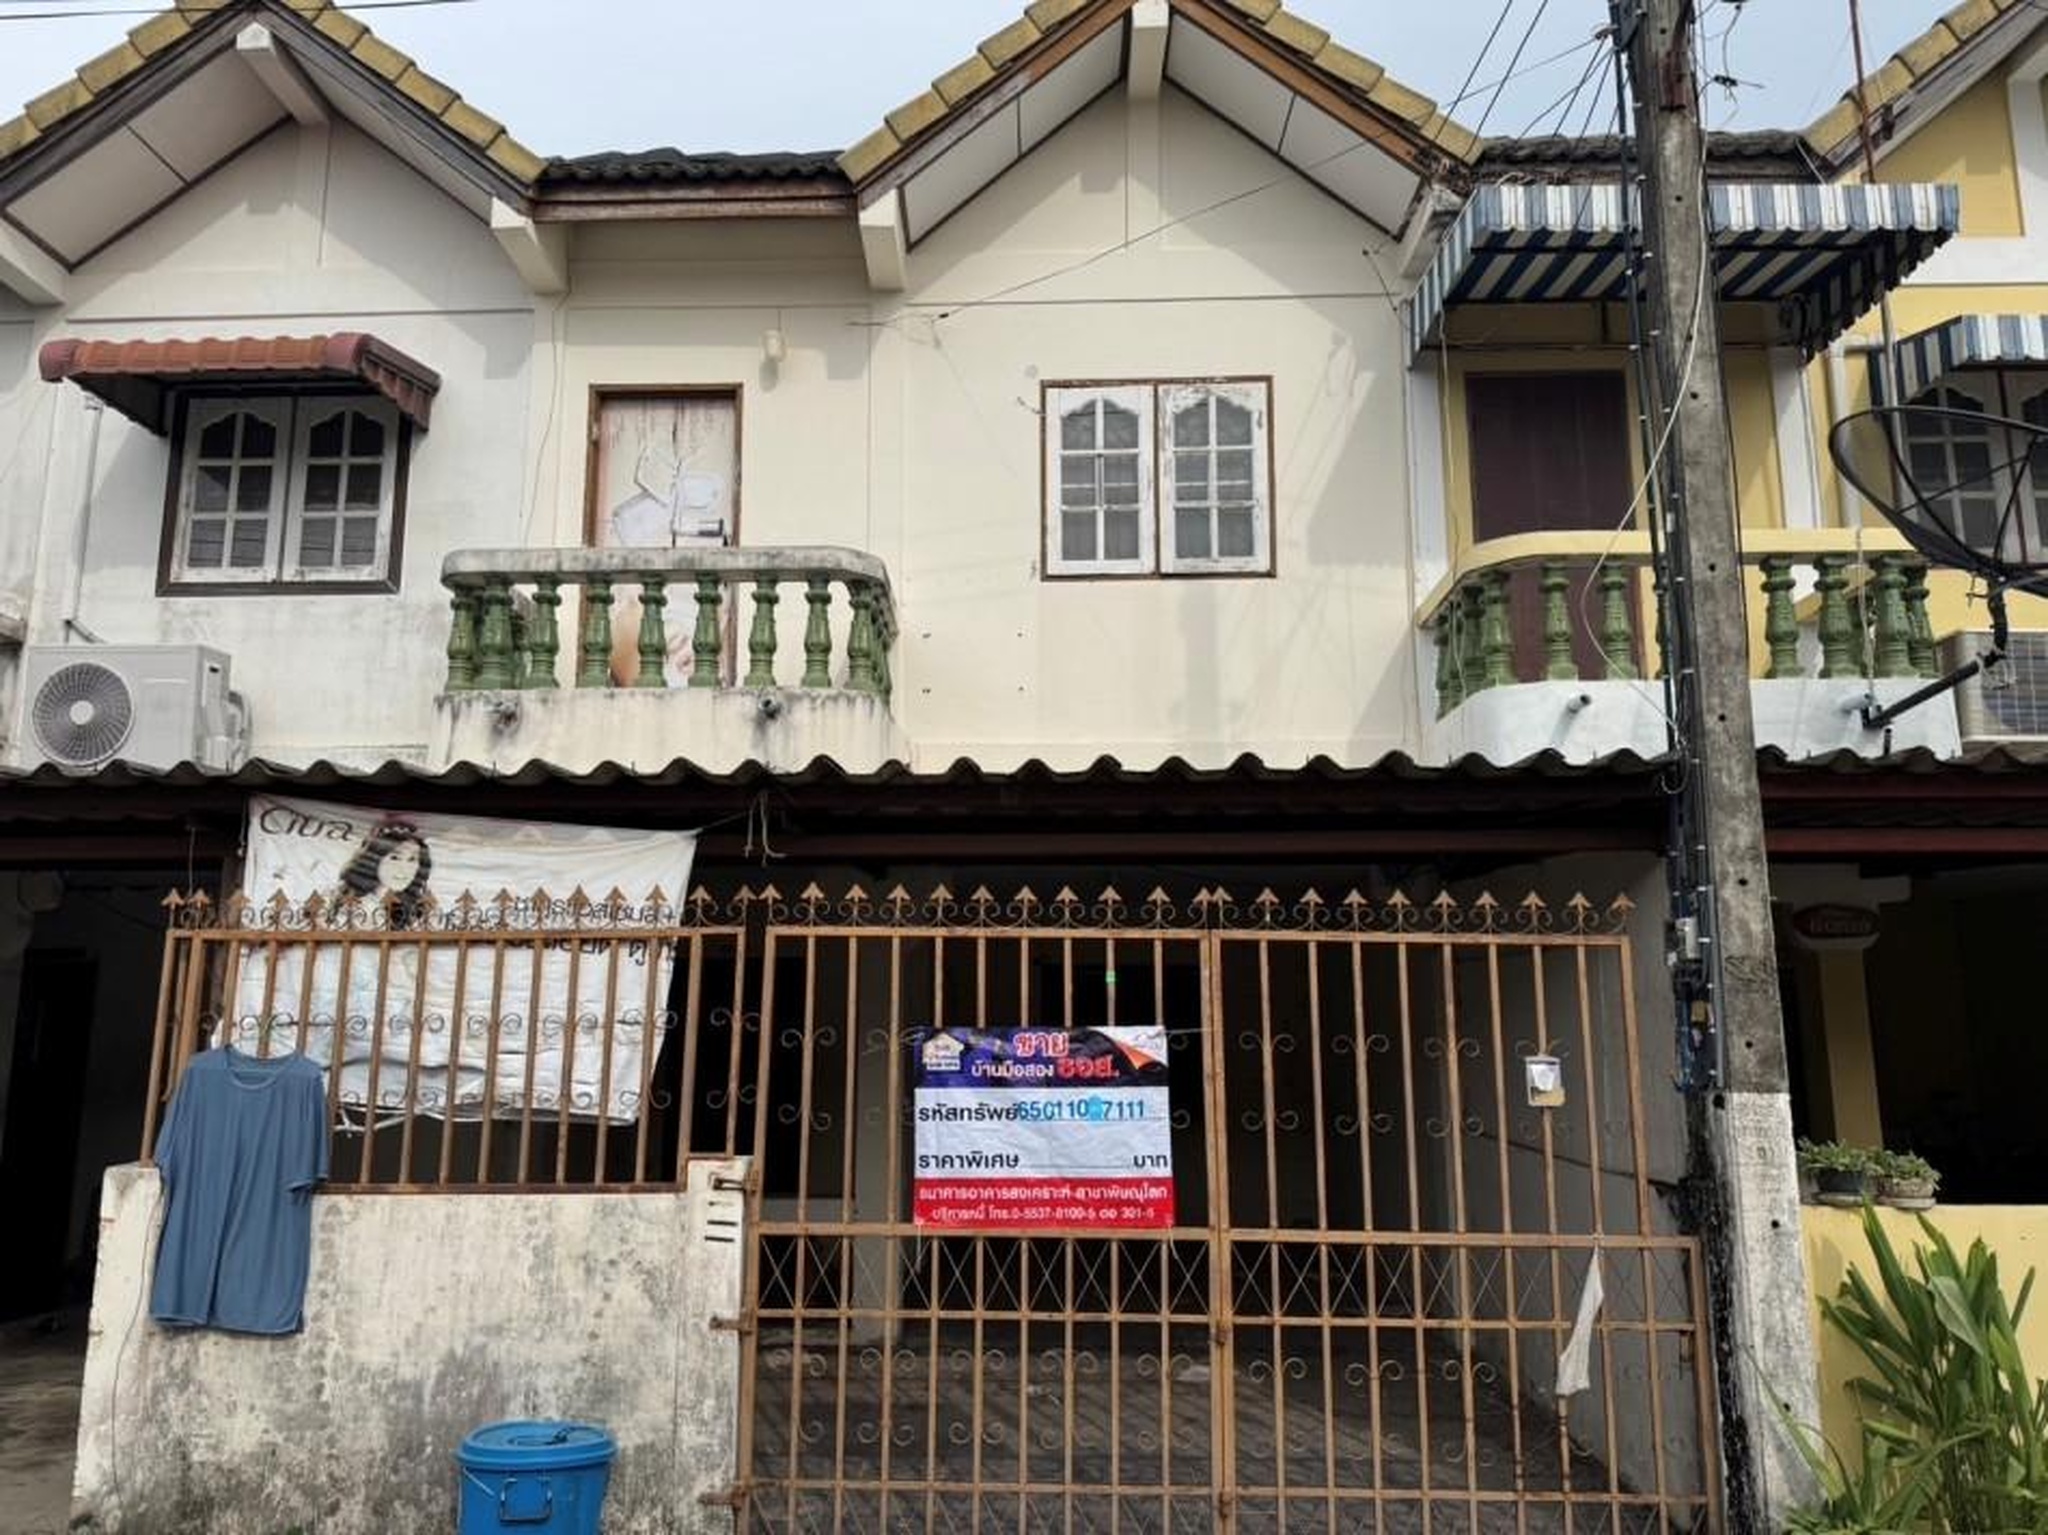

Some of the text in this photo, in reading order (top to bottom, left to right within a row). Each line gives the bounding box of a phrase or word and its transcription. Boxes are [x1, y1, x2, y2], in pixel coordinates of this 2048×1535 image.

[1013, 1032, 1069, 1057] ขาย
[971, 1058, 1054, 1078] บ้านมือสอง
[918, 1151, 1169, 1169] ราคาพิเศษ บาท
